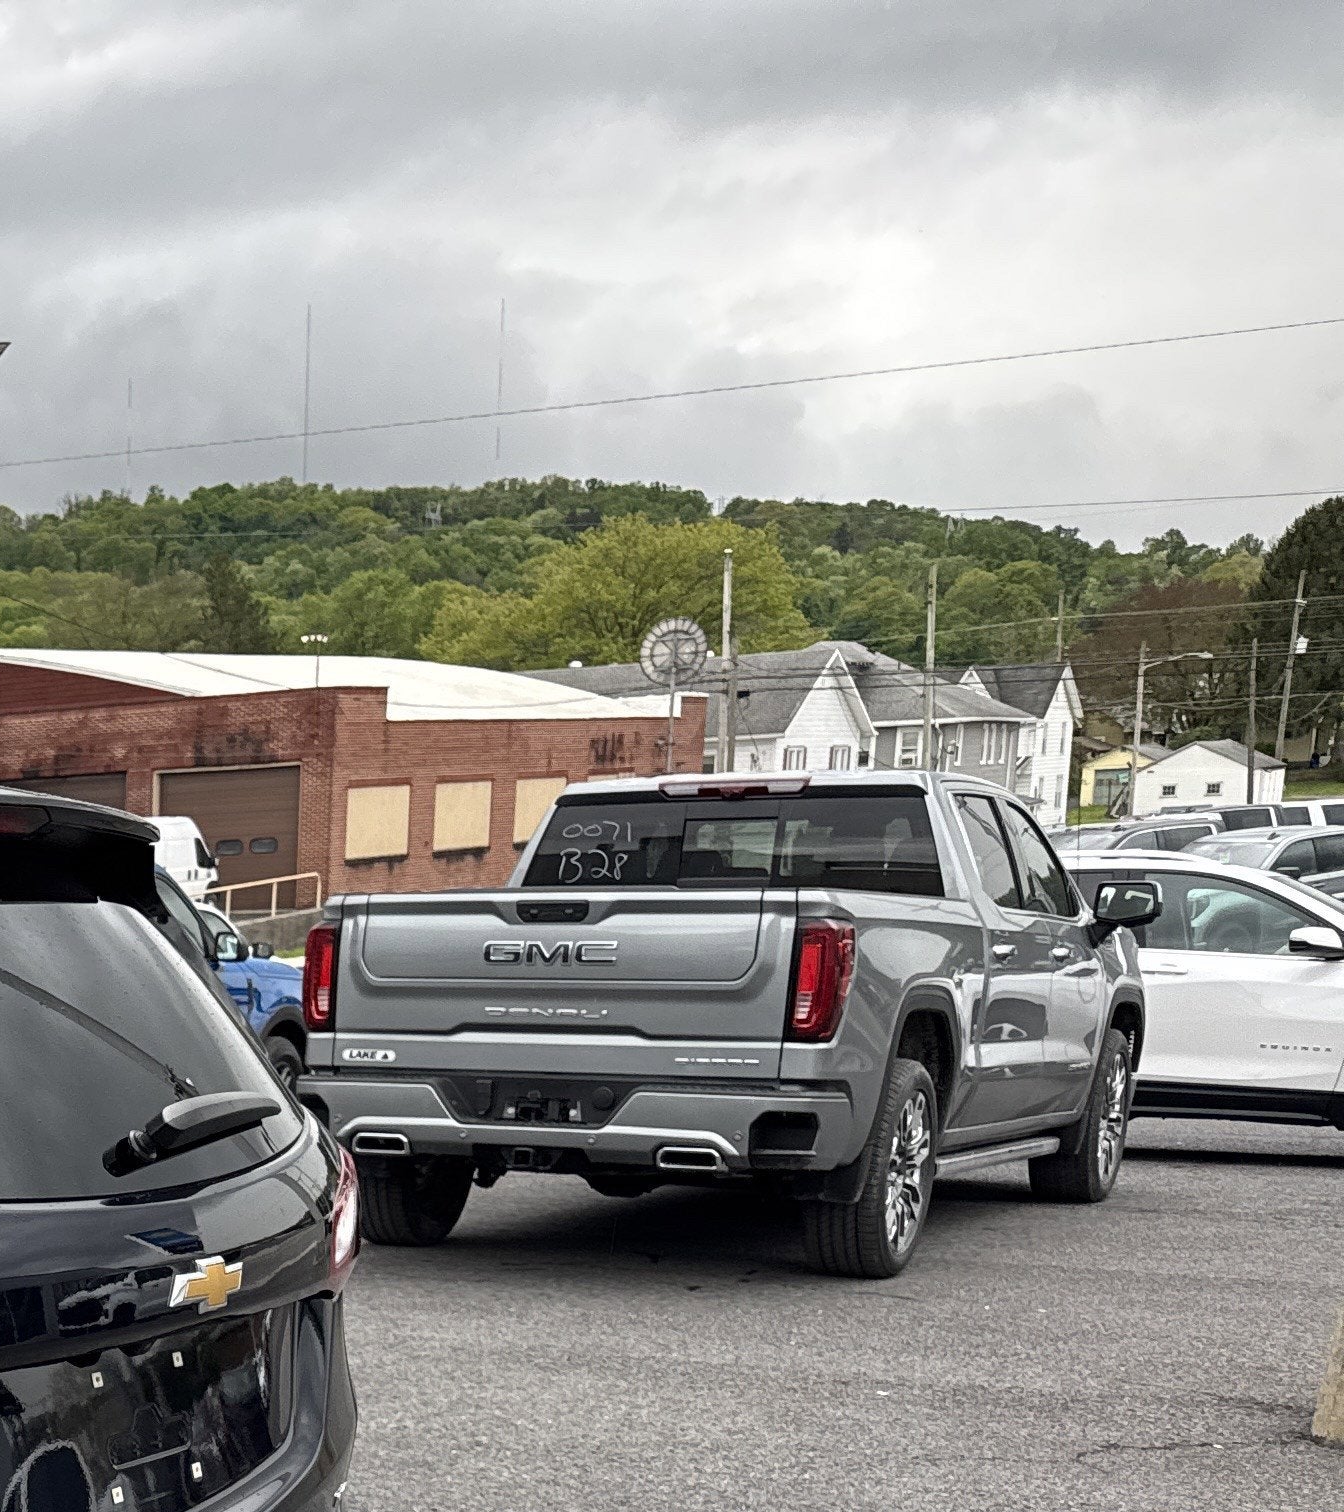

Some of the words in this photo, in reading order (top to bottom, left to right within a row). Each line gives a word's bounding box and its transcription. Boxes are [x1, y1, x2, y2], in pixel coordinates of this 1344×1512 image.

[562, 820, 632, 842] 0071
[558, 847, 629, 883] B28
[483, 940, 618, 966] GMC
